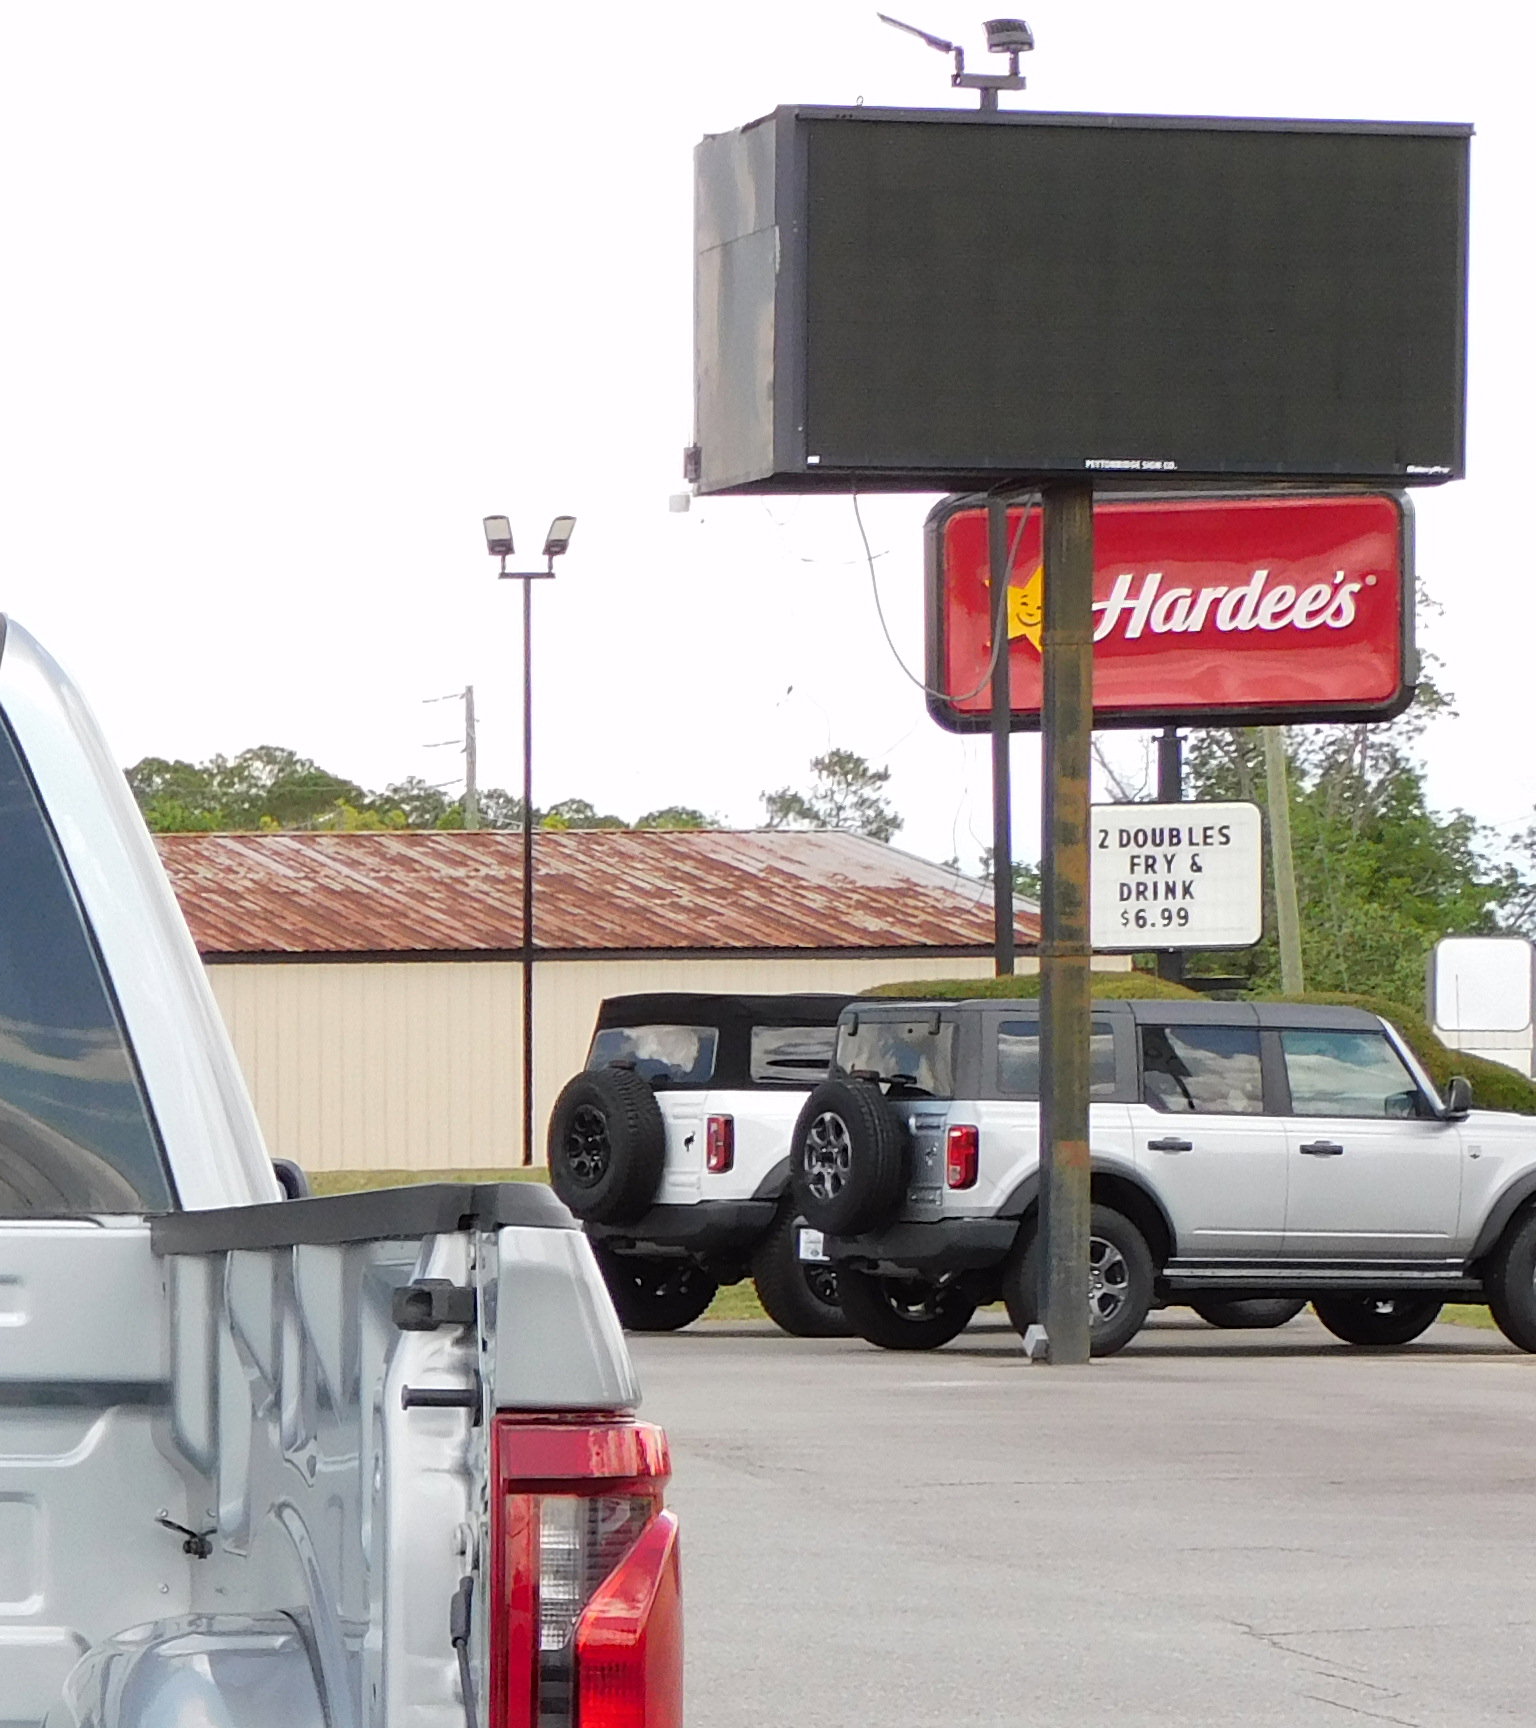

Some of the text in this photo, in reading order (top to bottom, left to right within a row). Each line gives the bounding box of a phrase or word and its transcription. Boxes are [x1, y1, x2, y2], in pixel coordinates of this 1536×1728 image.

[1092, 569, 1362, 642] Hardee's
[1098, 825, 1231, 850] 2 DOUBLES
[1129, 853, 1203, 875] FRY &
[1119, 880, 1195, 902] DRINK
[1120, 907, 1190, 929] $6.99
